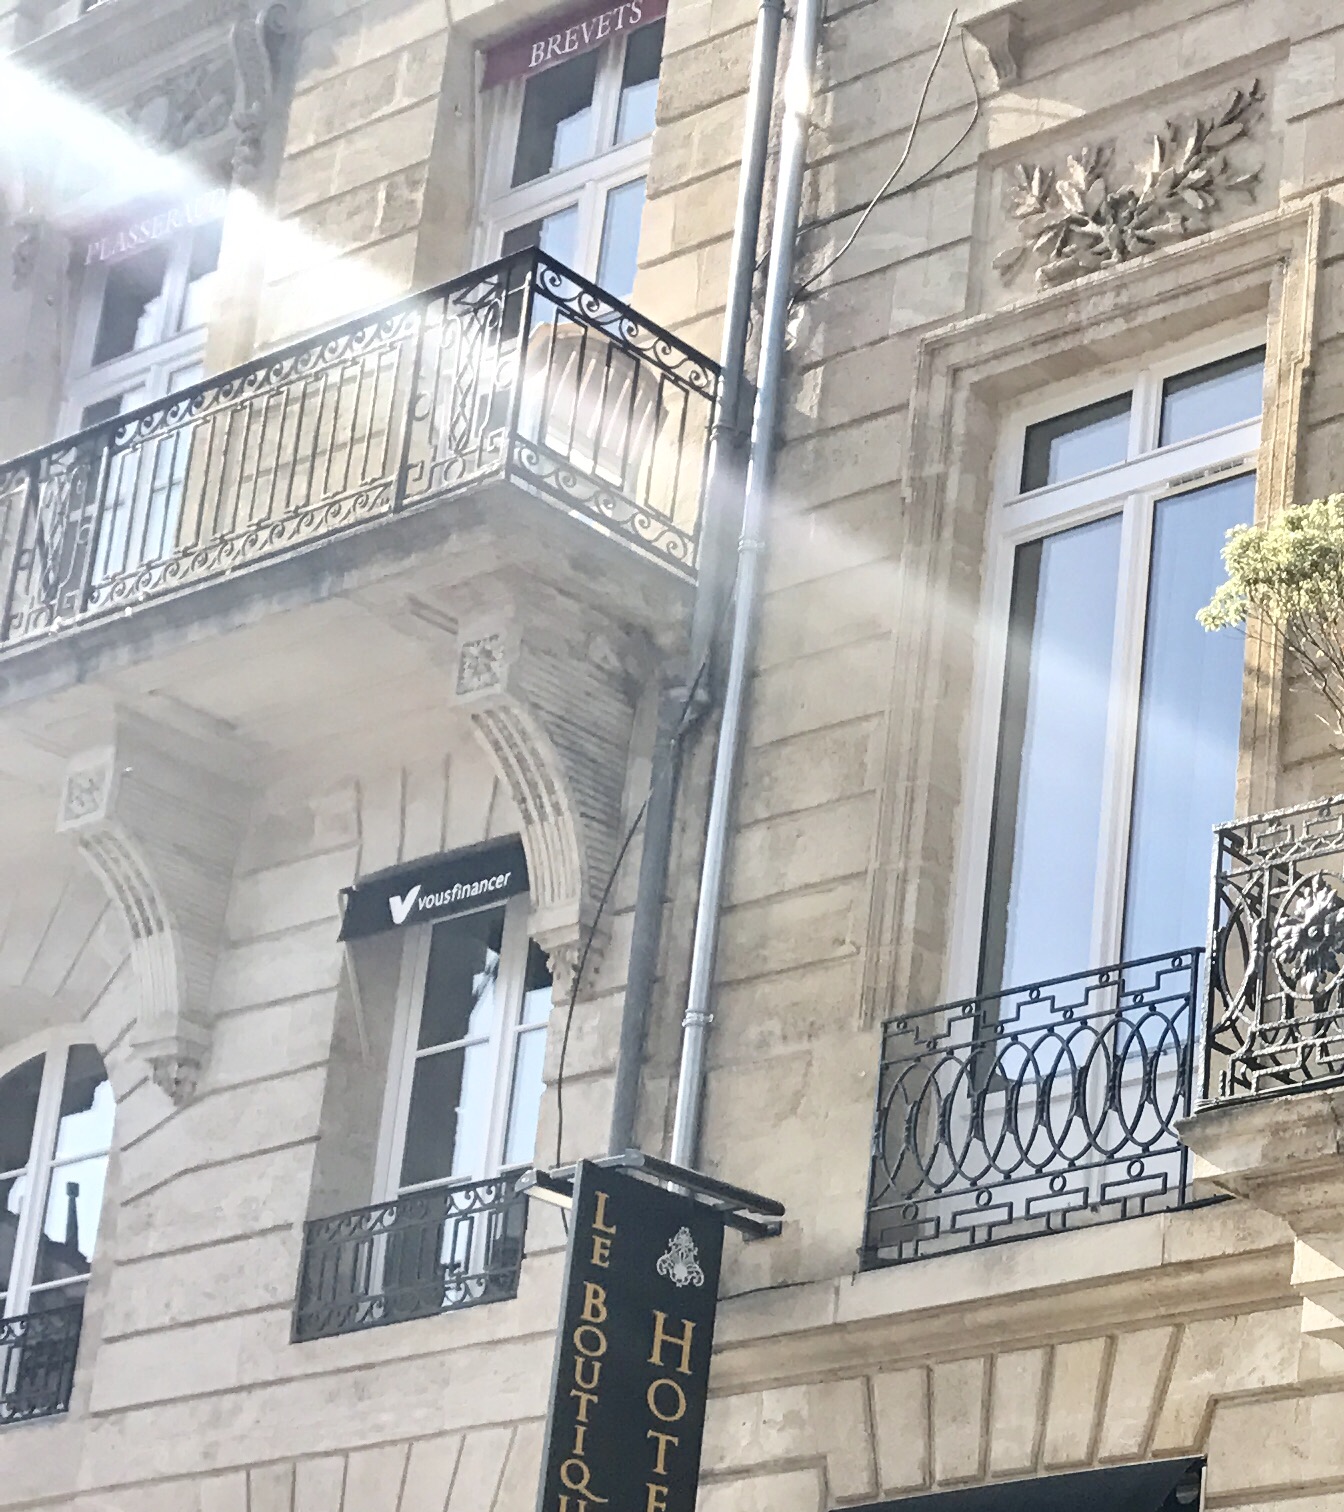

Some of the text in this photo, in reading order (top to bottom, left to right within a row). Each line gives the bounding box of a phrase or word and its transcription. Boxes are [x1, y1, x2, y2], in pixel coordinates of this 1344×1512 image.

[528, 0, 642, 68] BREVETS
[418, 872, 512, 911] vousfinancer
[592, 1191, 617, 1268] LE
